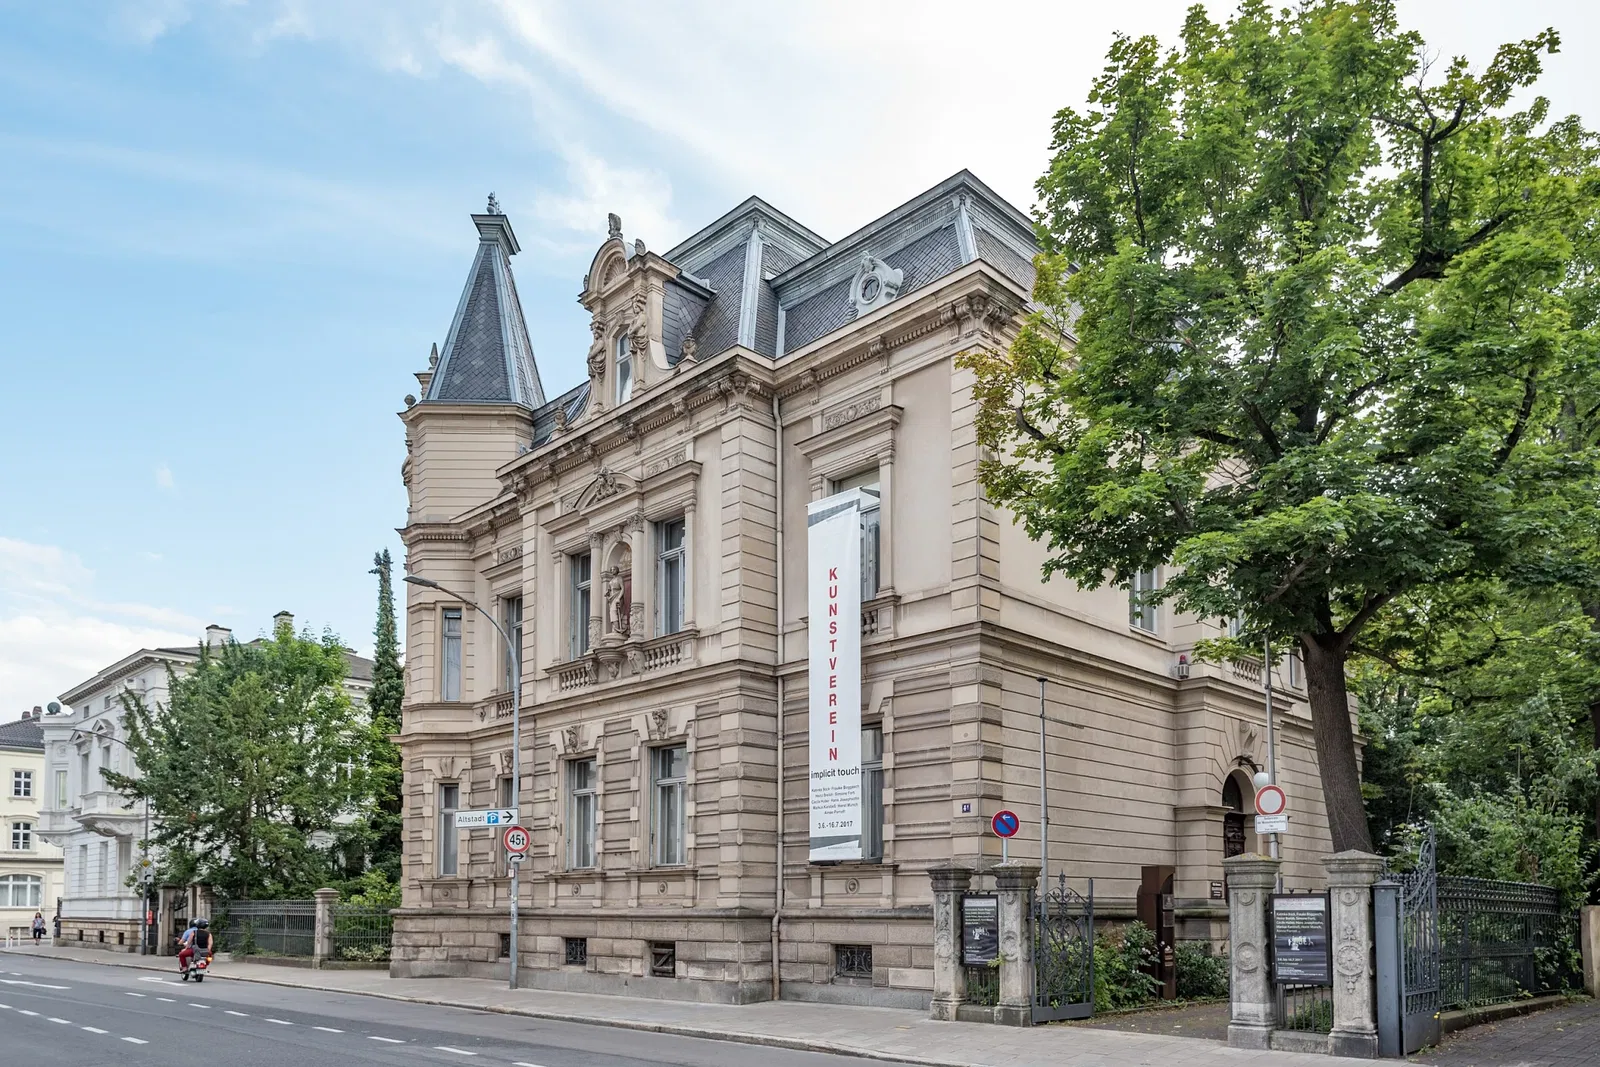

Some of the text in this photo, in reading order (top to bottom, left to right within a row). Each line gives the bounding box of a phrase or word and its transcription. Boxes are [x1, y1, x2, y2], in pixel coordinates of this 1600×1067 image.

[829, 568, 838, 760] KUNSTVEREIN
[811, 766, 860, 780] implicit touch
[510, 834, 525, 846] 45t
